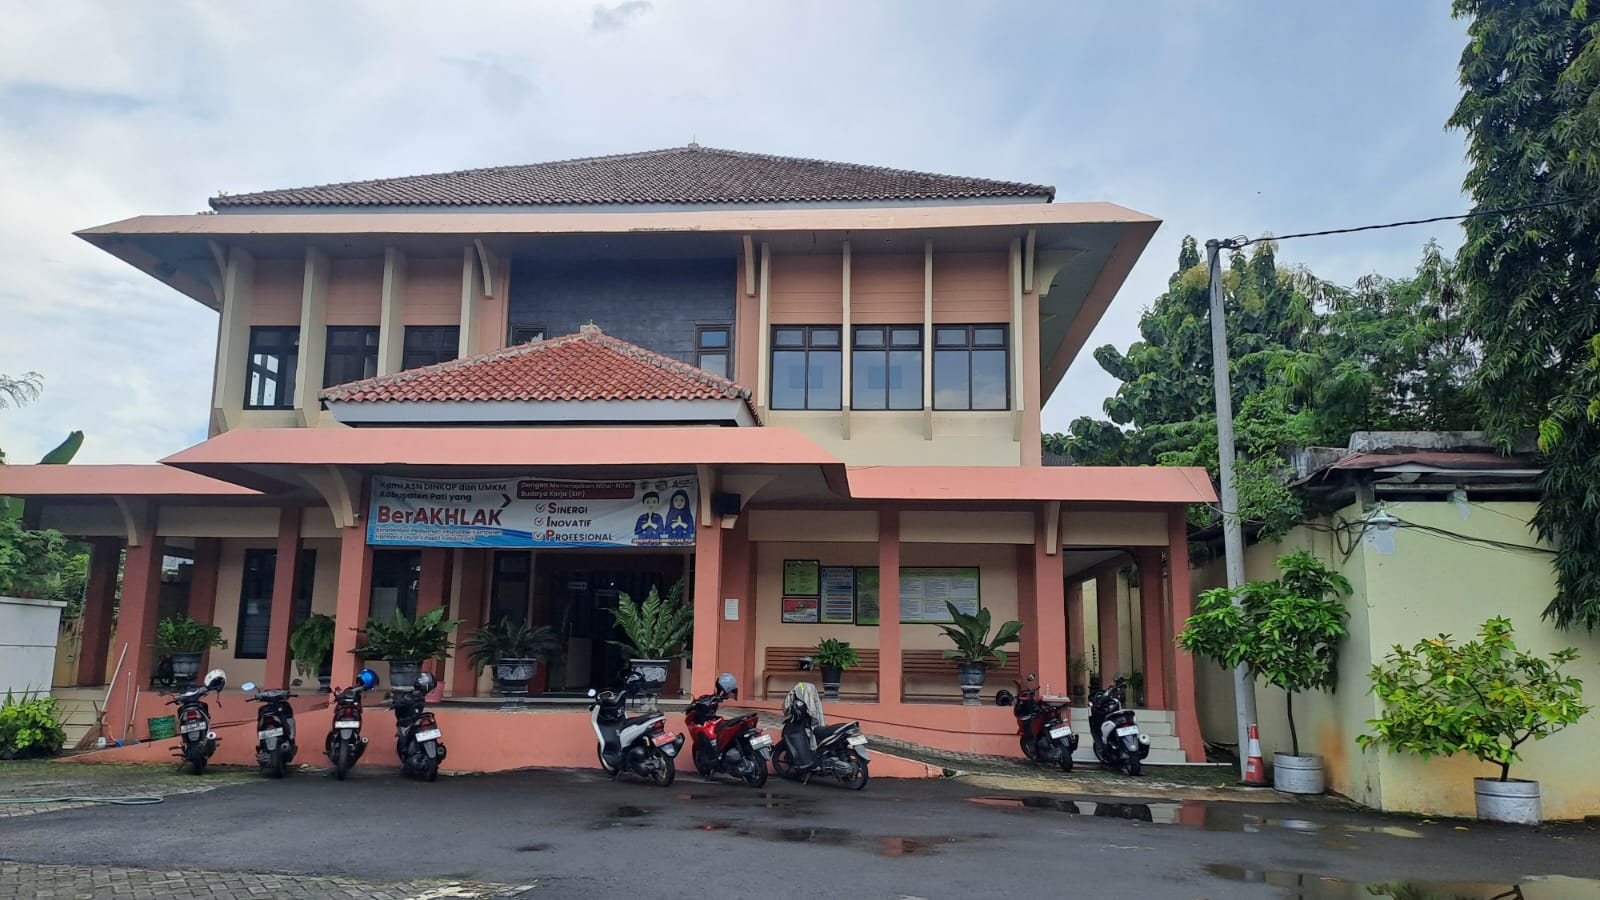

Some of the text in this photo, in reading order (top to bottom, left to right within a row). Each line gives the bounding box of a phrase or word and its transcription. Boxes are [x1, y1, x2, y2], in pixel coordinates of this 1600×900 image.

[380, 481, 403, 490] Kami
[424, 483, 457, 491] DINKOP
[459, 483, 476, 491] dan
[478, 484, 507, 492] UMKM
[379, 491, 472, 502] Kabupaten Pati yang
[377, 505, 503, 526] BerAKHLAK
